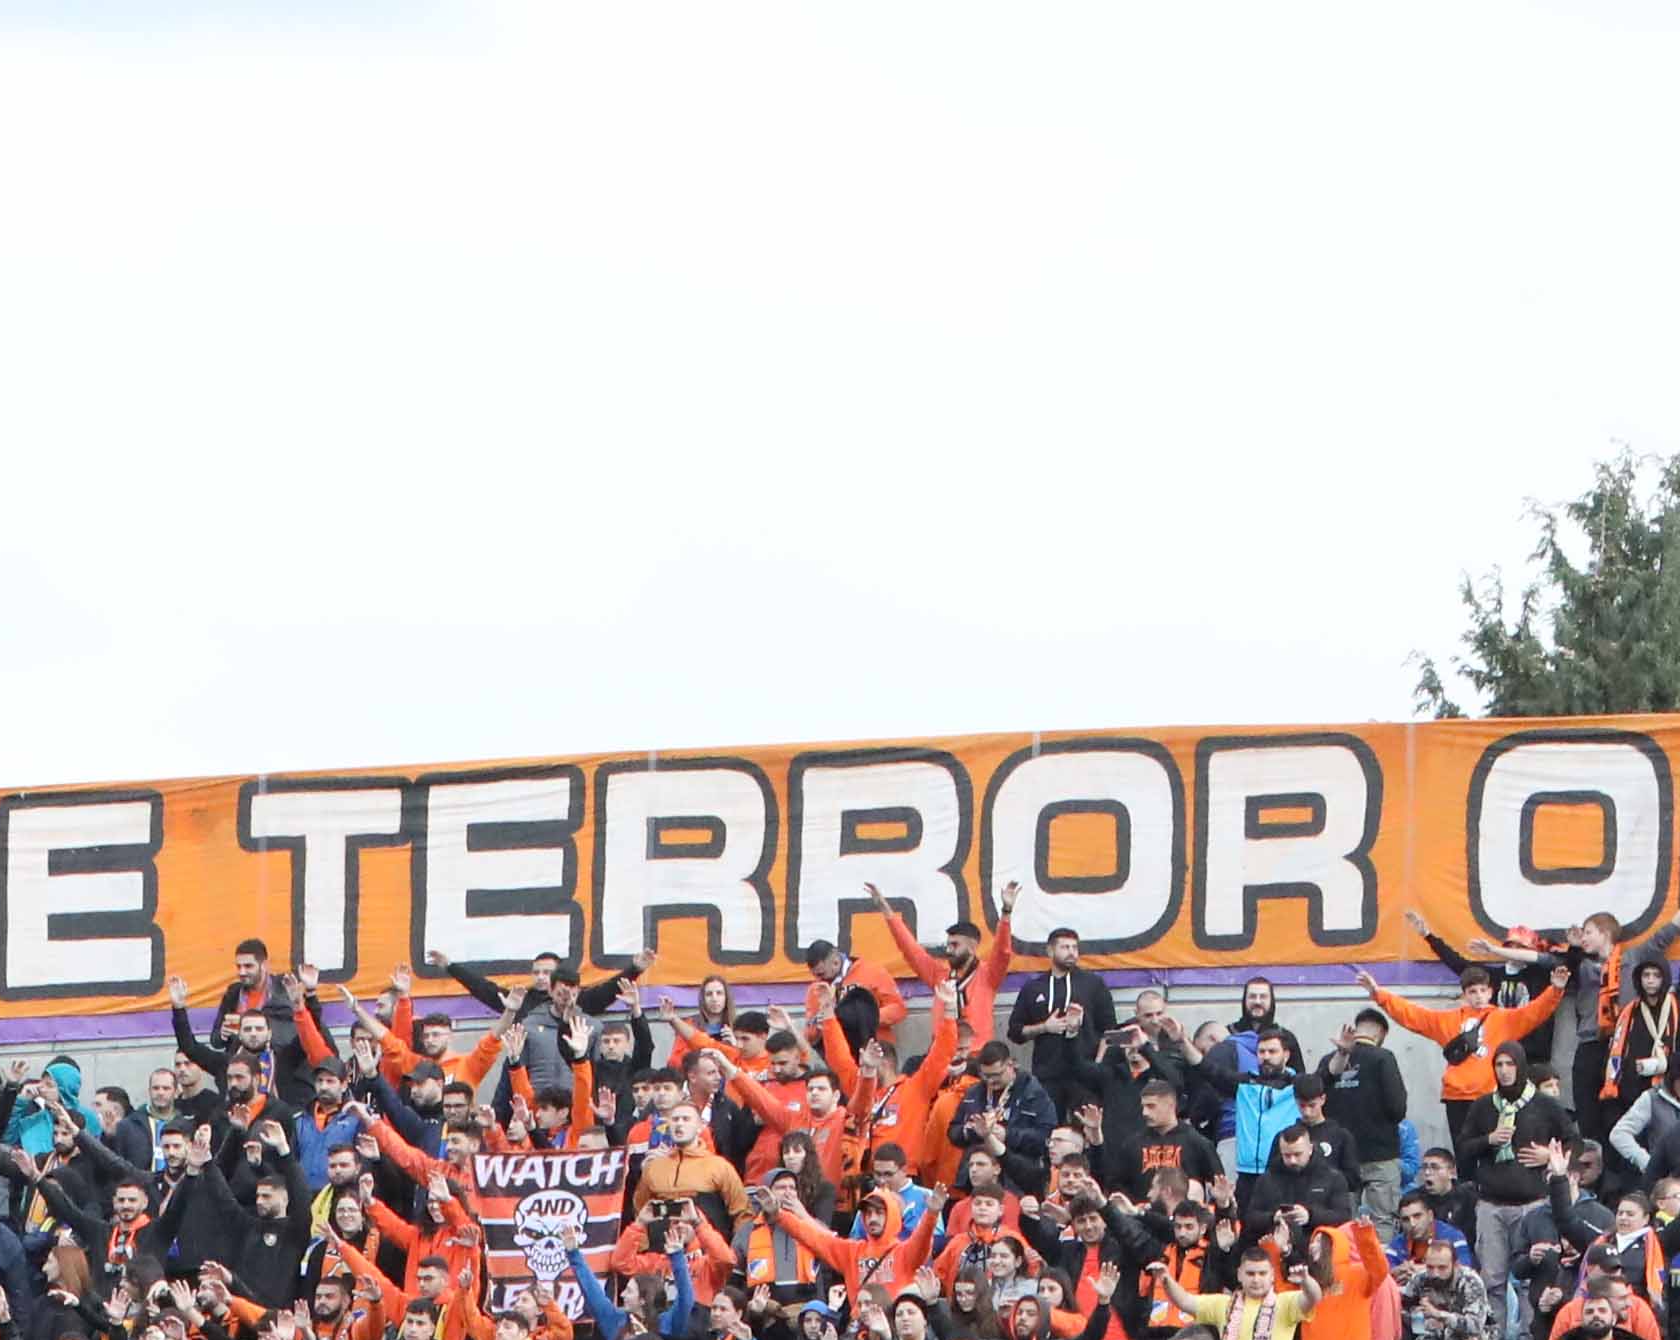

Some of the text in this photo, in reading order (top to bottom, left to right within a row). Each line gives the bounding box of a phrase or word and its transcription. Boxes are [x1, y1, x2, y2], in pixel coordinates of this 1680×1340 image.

[240, 731, 1383, 984] TERROR
[475, 1150, 624, 1188] WATCH
[527, 1198, 576, 1216] AND
[489, 1280, 608, 1321] LER
